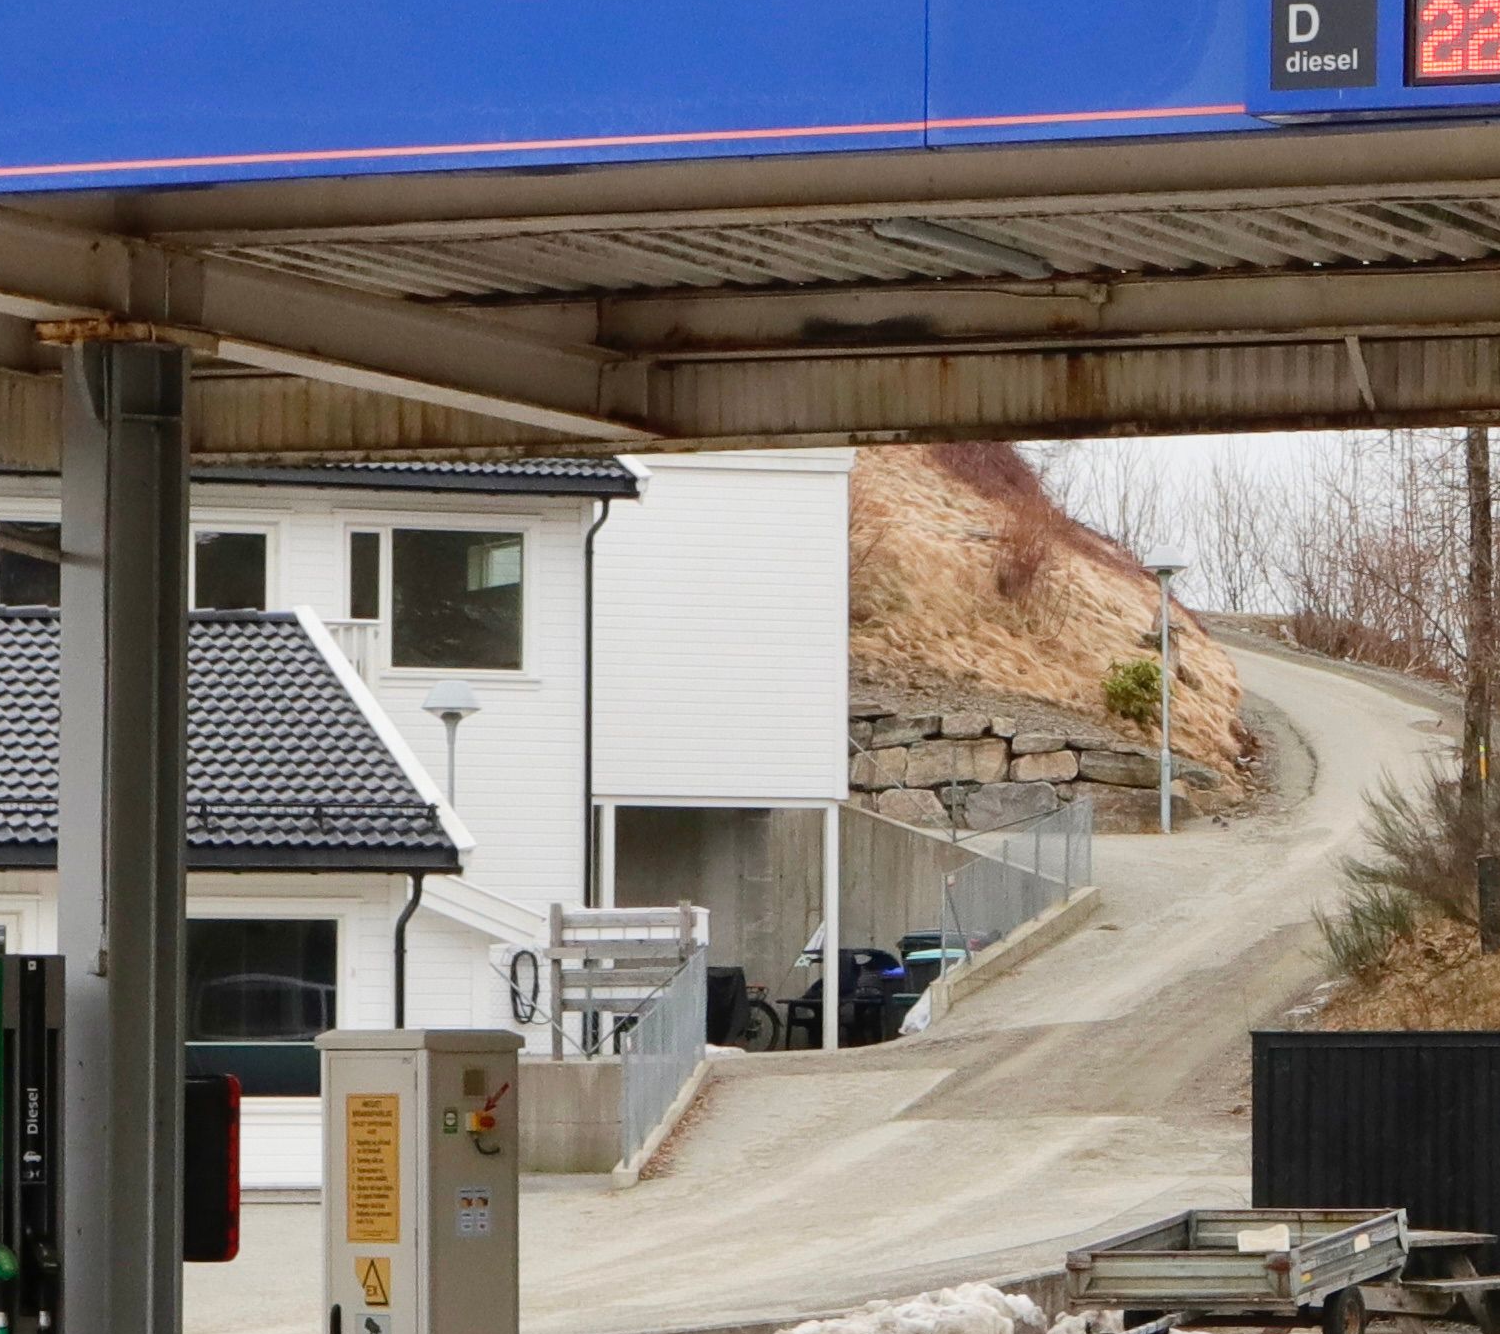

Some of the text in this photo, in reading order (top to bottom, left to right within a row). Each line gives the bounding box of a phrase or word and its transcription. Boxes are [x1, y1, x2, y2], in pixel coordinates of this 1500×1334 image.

[1288, 3, 1320, 44] D
[1285, 48, 1359, 73] diesel
[27, 1088, 38, 1134] Diesel
